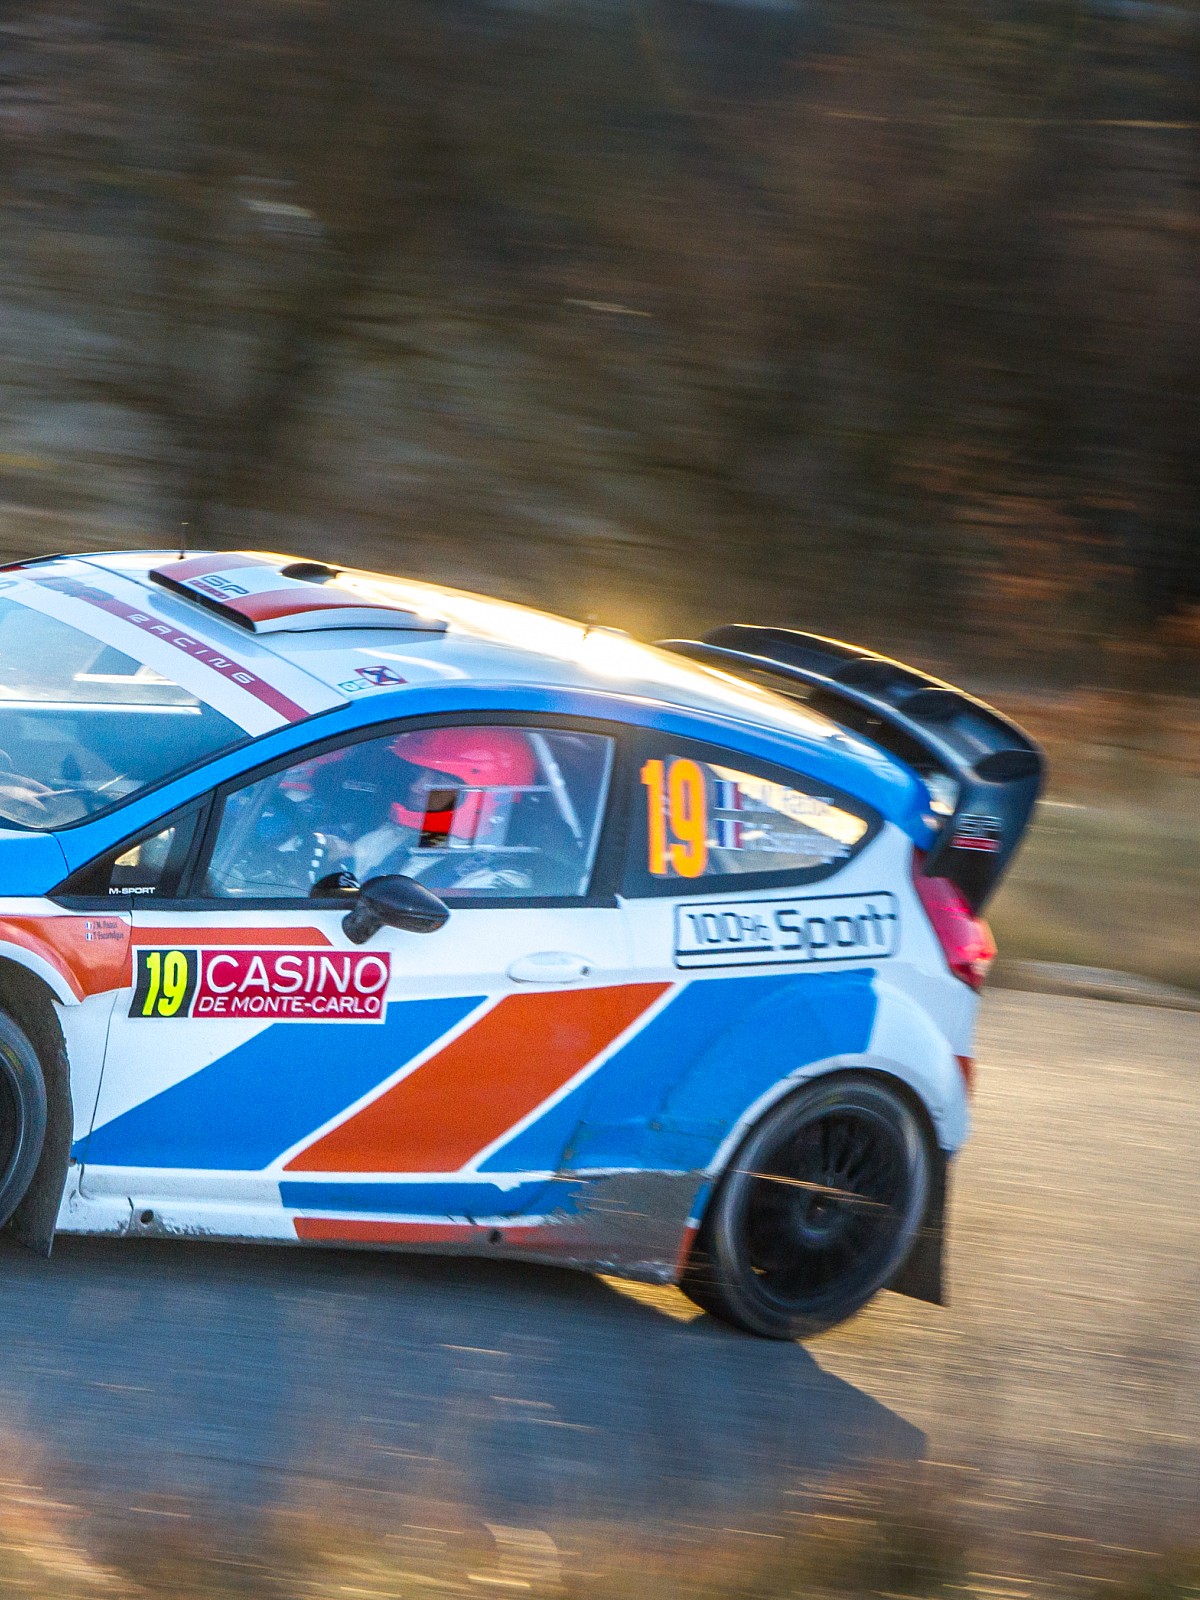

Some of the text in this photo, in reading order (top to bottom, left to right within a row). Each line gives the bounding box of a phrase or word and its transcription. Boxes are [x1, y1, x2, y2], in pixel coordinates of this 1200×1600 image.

[127, 612, 256, 685] RACING
[640, 759, 708, 878] 19
[687, 904, 887, 959] 100% Sport
[142, 950, 188, 1017] 19
[199, 996, 381, 1014] DE MONTE-CARLO
[206, 954, 389, 995] CASINO
